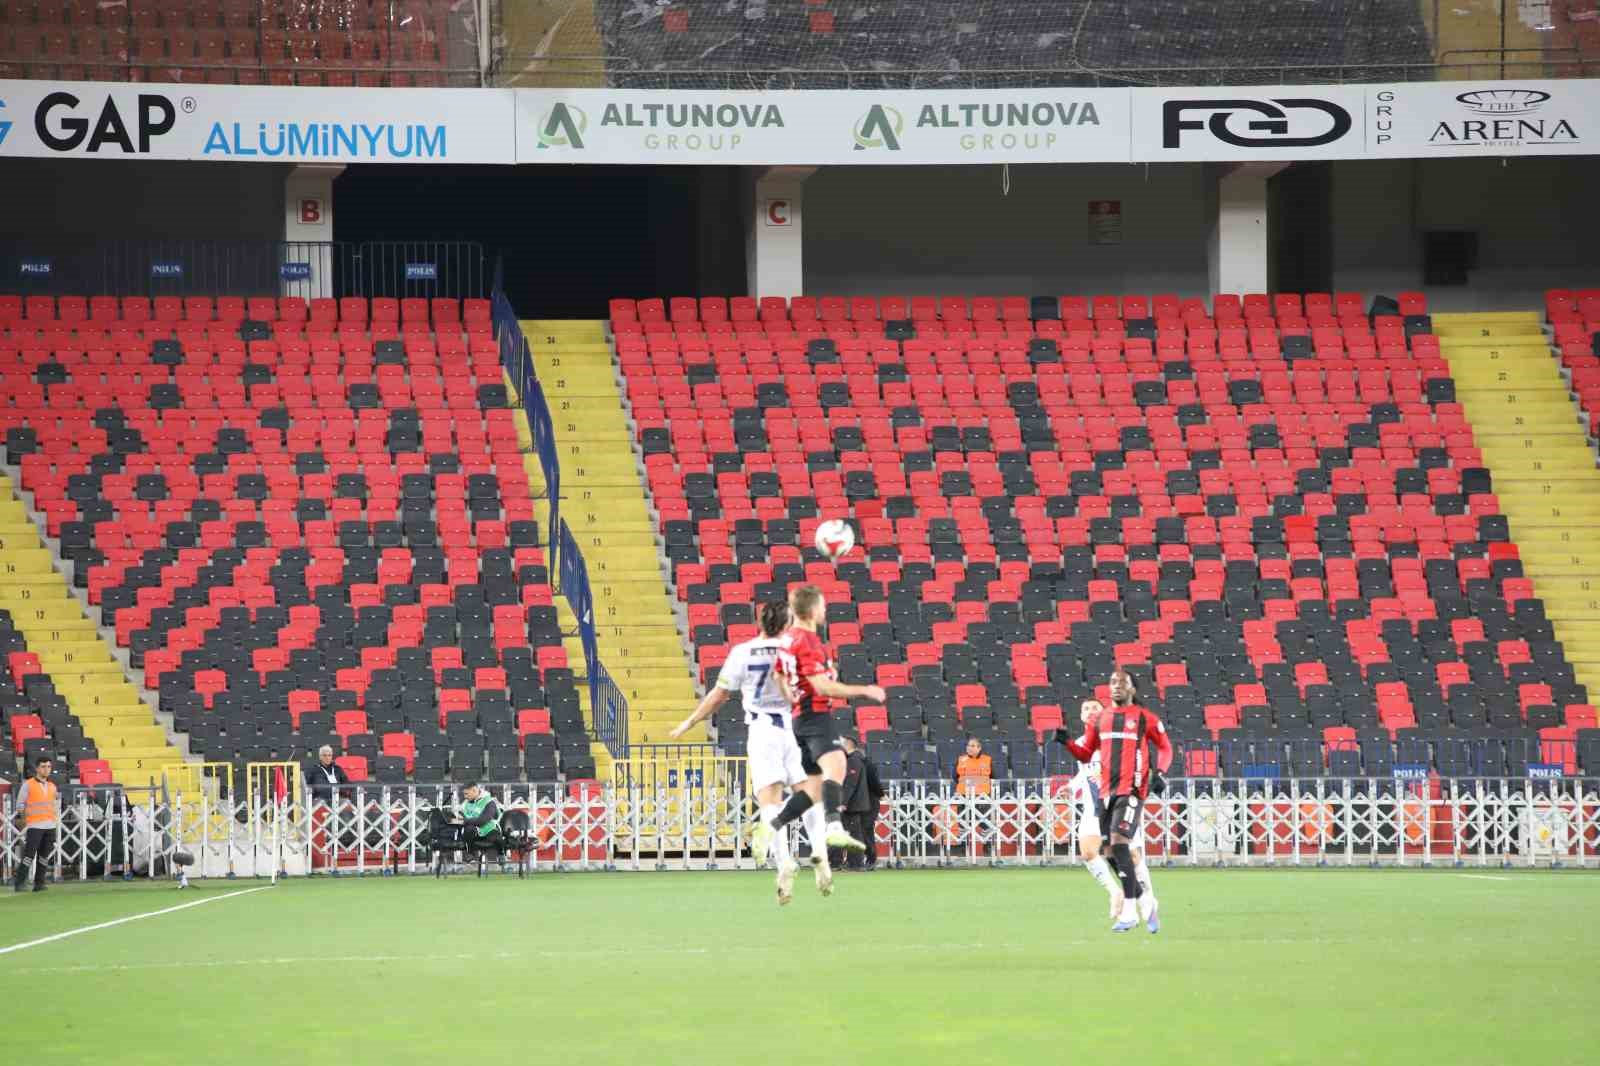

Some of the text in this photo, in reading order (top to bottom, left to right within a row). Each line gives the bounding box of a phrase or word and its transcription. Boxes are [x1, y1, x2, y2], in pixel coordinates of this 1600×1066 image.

[34, 91, 175, 153] GAP
[600, 103, 785, 128] ALTUNOVA
[916, 102, 1101, 128] ALTUNOVA
[1376, 91, 1395, 145] GRUP
[643, 133, 743, 152] GROUP
[959, 132, 1058, 151] GROUP
[1428, 119, 1581, 142] ARENA
[302, 200, 319, 222] B
[768, 201, 787, 223] C
[747, 663, 770, 699] 7
